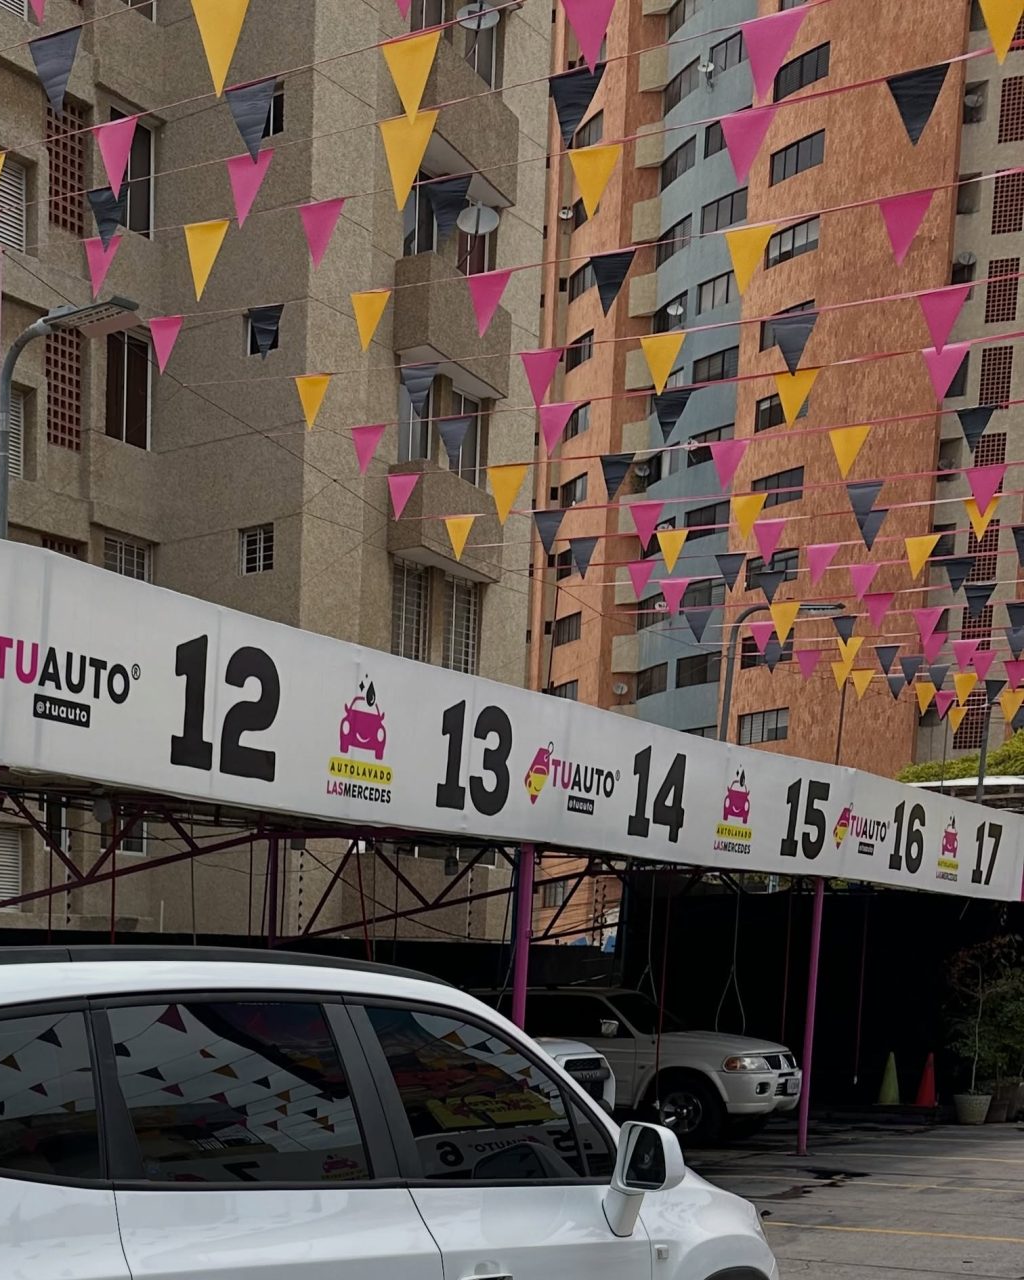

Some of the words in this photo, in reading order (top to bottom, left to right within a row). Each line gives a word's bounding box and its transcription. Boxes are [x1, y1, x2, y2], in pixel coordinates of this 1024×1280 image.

[35, 700, 88, 722] @tuauto
[170, 634, 281, 782] 12
[326, 780, 392, 804] LASMERCEDES
[329, 761, 392, 782] AUTOLAVADO
[436, 700, 513, 816] 13
[627, 745, 686, 843] 14
[780, 777, 830, 860] 15
[888, 800, 926, 874] 16
[971, 821, 1002, 885] 17
